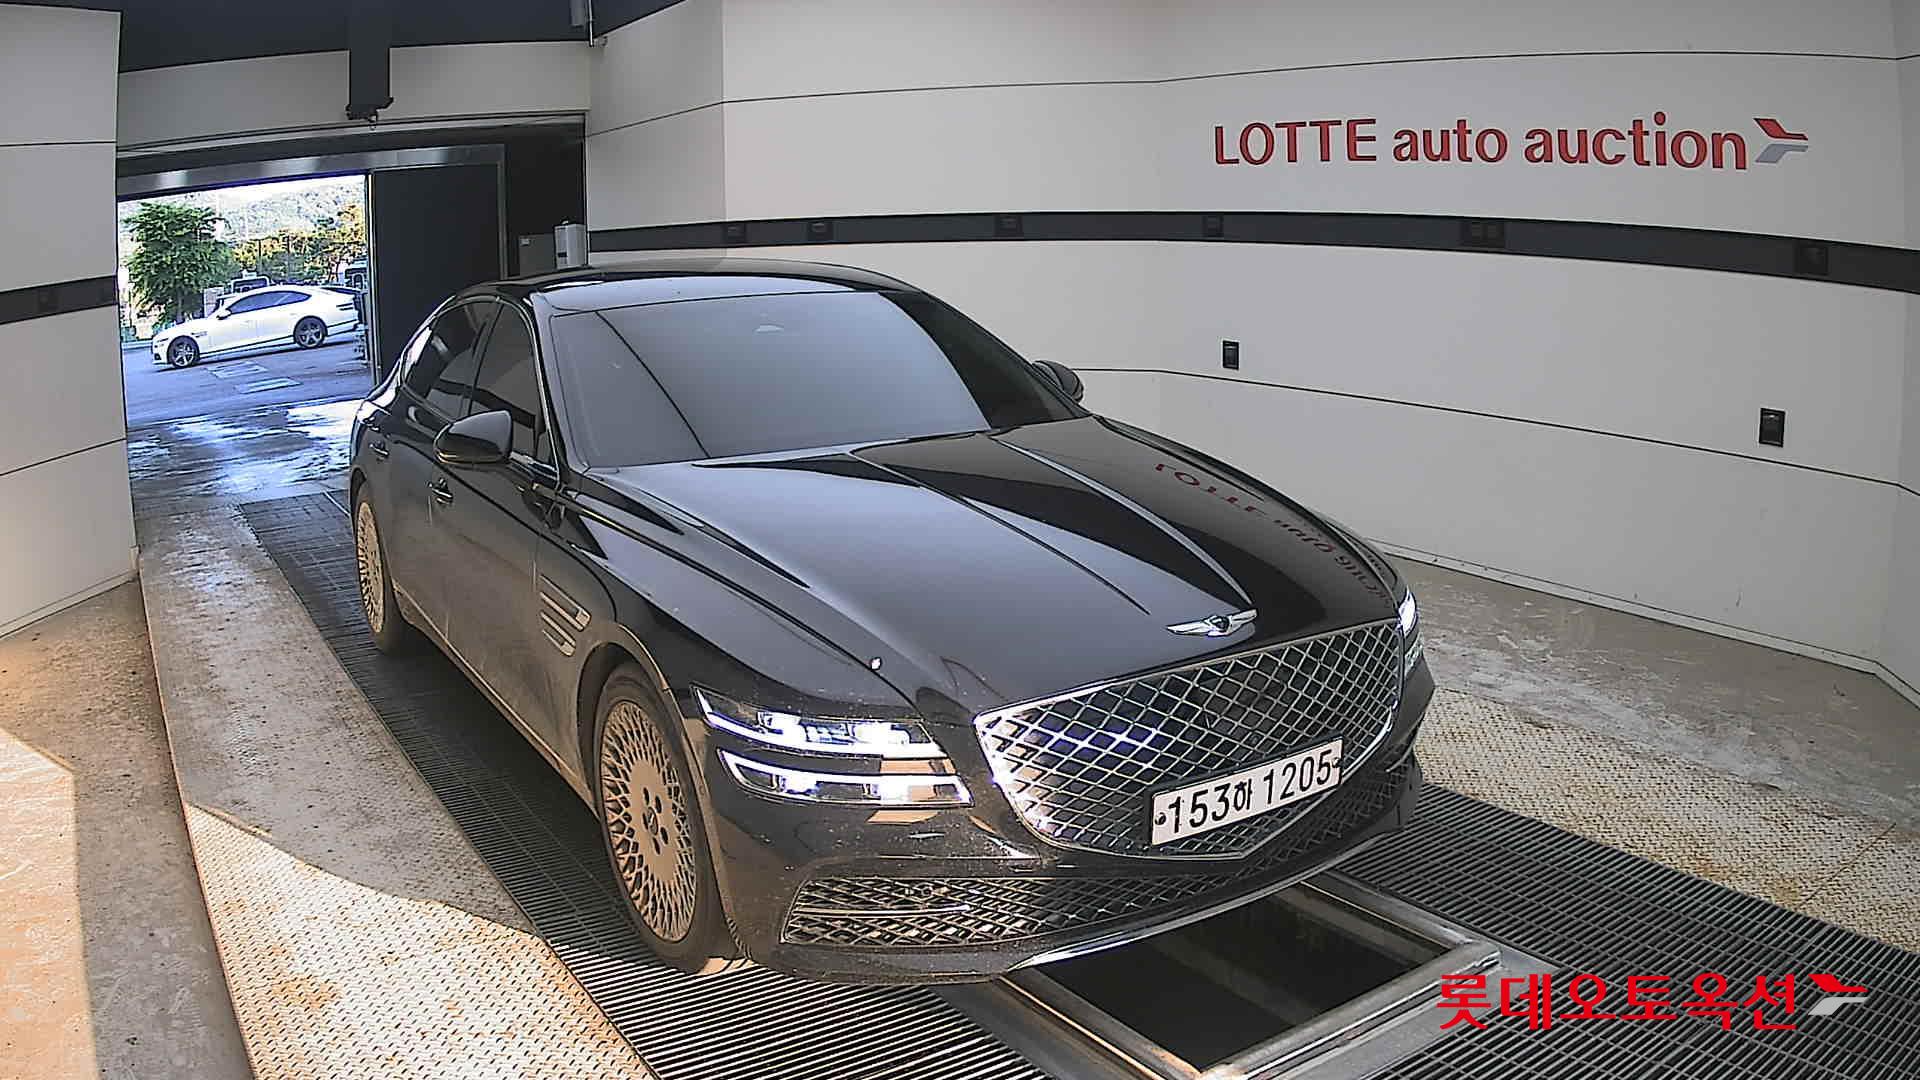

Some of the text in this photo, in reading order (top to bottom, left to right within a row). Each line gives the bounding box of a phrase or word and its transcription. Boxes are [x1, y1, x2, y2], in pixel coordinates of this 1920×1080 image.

[1214, 111, 1748, 170] LOTTE auto auction
[1168, 749, 1333, 834] 153하 1205
